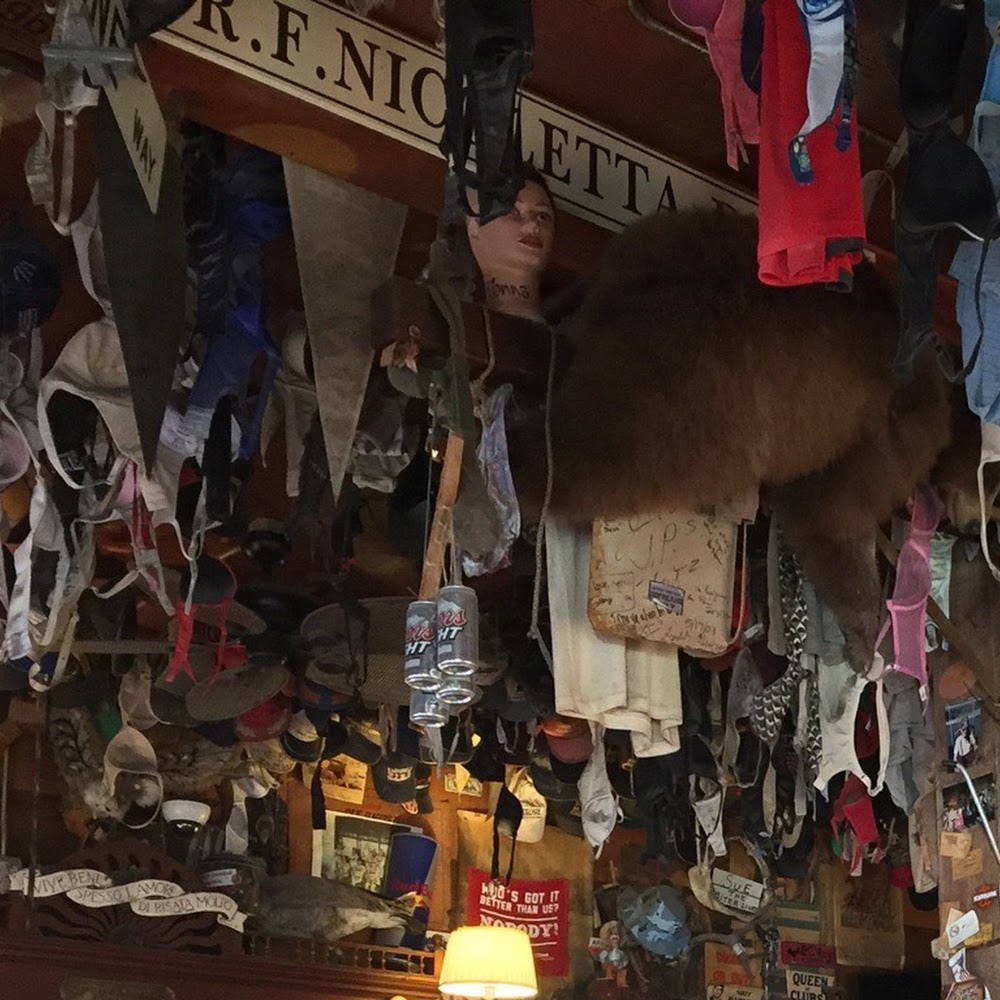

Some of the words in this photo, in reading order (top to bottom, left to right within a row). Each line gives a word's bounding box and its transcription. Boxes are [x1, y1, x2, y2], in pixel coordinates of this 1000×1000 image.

[132, 108, 156, 183] WAY
[479, 896, 512, 912] BETTER
[517, 903, 539, 914] THAN
[542, 902, 559, 914] US?
[525, 891, 544, 903] GOT
[550, 890, 560, 901] IT
[793, 972, 829, 988] QUEEN
